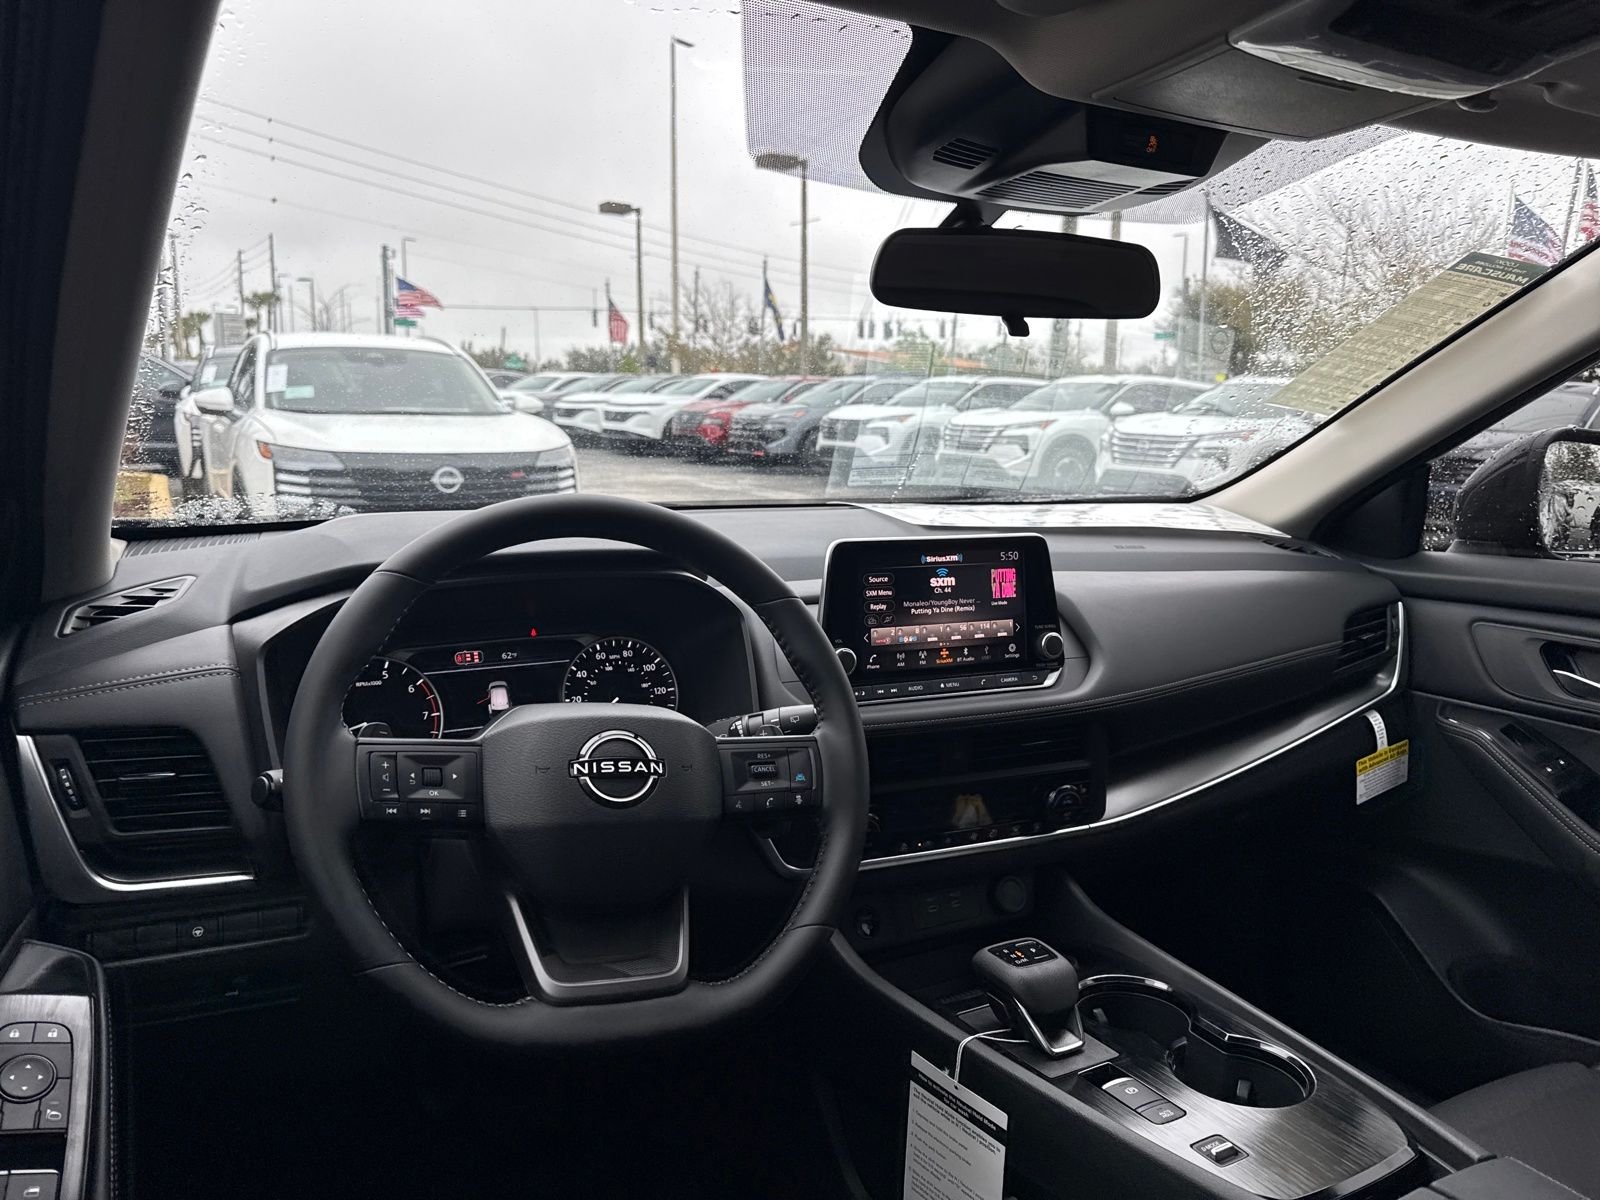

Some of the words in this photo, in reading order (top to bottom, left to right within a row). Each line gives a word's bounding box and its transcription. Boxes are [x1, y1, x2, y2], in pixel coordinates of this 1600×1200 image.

[1000, 552, 1018, 560] 5:50
[990, 568, 1016, 583] PUTTING
[930, 577, 956, 587] sxm
[595, 652, 606, 660] 60
[643, 663, 656, 671] 100
[382, 671, 388, 679] 5
[422, 712, 428, 720] 7
[574, 761, 663, 774] NISSAN
[918, 1073, 927, 1082] How
[983, 1118, 996, 1130] Mode
